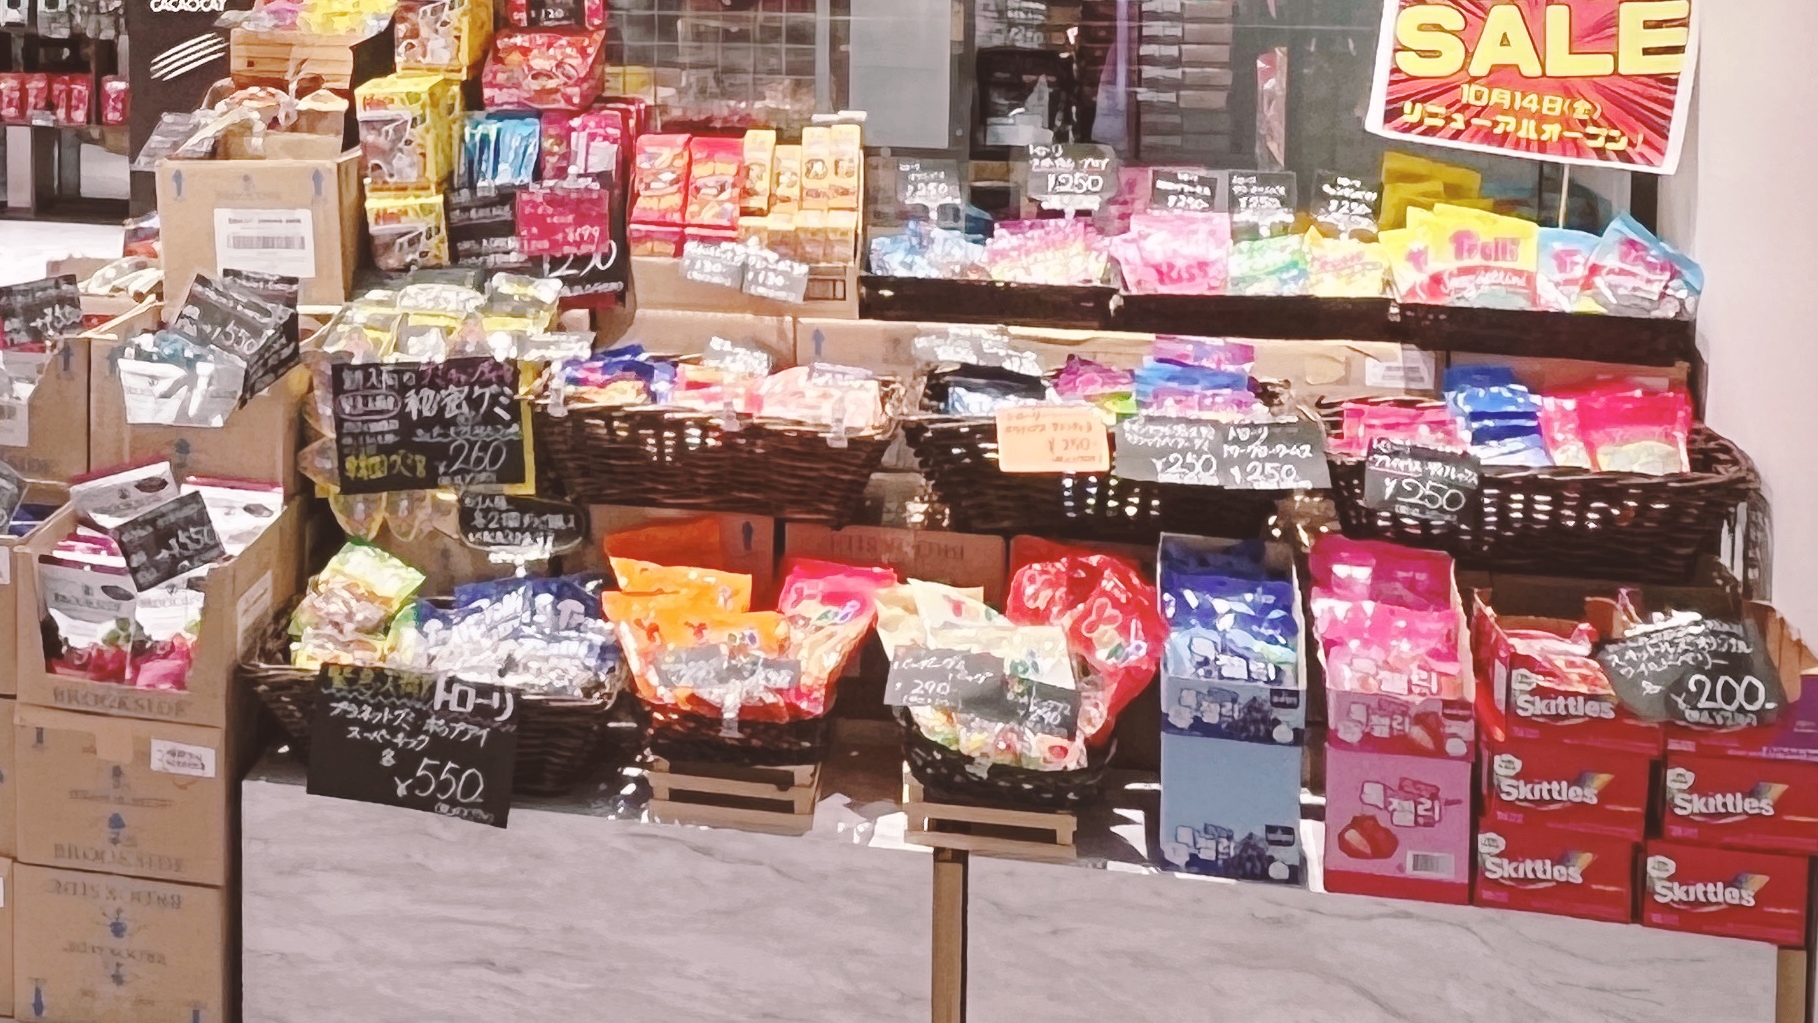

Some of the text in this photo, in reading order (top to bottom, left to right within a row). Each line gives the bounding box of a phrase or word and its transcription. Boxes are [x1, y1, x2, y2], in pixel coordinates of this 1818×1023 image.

[1395, 0, 1690, 78] SALE
[1516, 693, 1615, 720] Skittles
[1500, 780, 1598, 805] Skittles
[1674, 792, 1774, 817] Skittles
[1485, 858, 1583, 883] Skittles
[1654, 881, 1756, 907] Skittles
